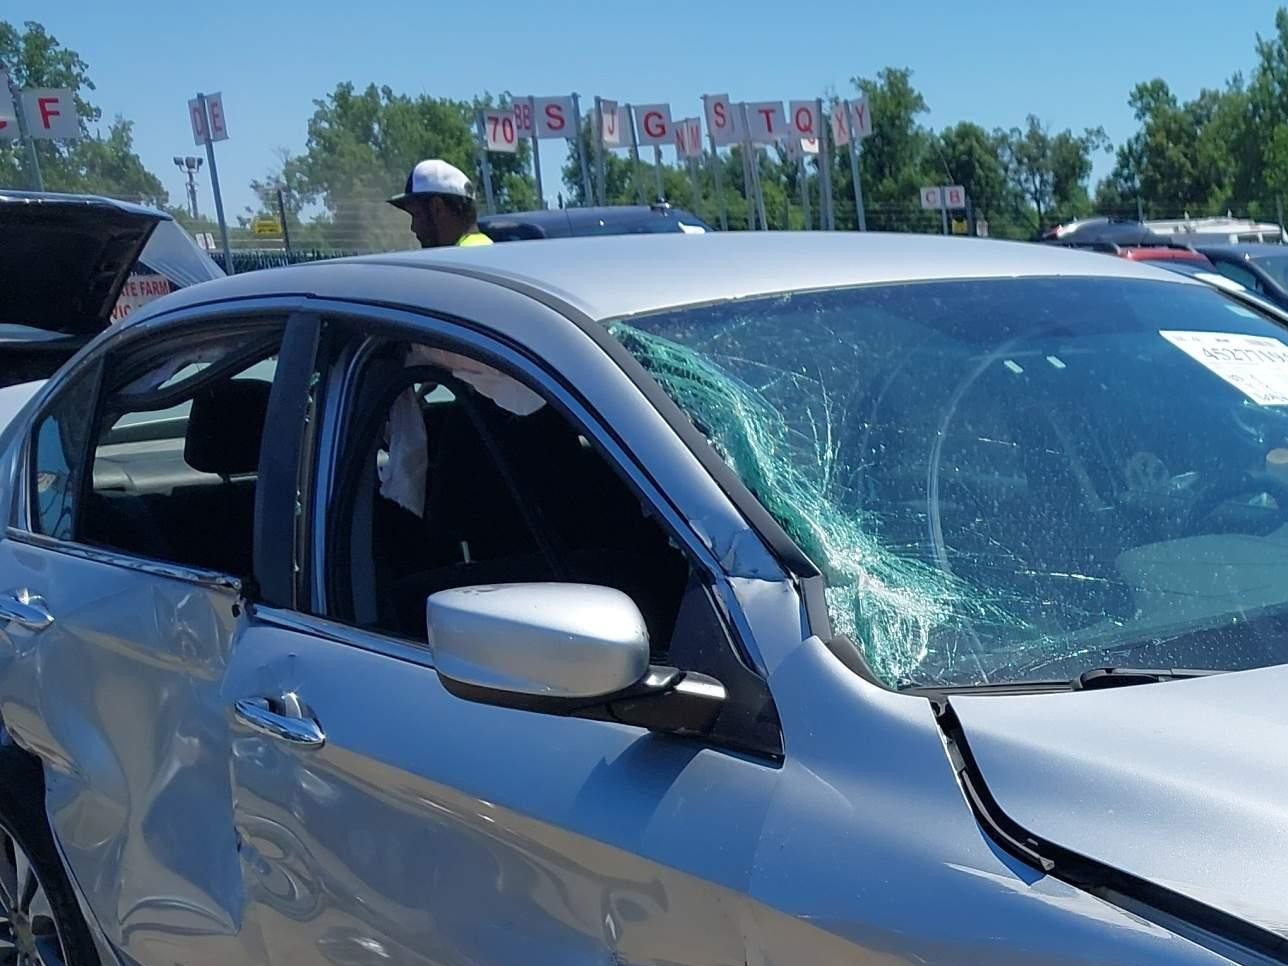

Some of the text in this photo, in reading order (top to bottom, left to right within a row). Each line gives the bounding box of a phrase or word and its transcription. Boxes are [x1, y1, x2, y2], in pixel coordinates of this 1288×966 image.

[38, 97, 60, 129] F
[211, 102, 223, 132] E
[545, 103, 565, 130] S
[643, 111, 666, 138] G
[713, 102, 726, 129] S
[758, 108, 775, 133] T
[795, 107, 813, 134] Q
[835, 103, 865, 138] X Y
[487, 115, 514, 144] 70
[949, 190, 960, 204] B
[140, 281, 169, 296] FARM
